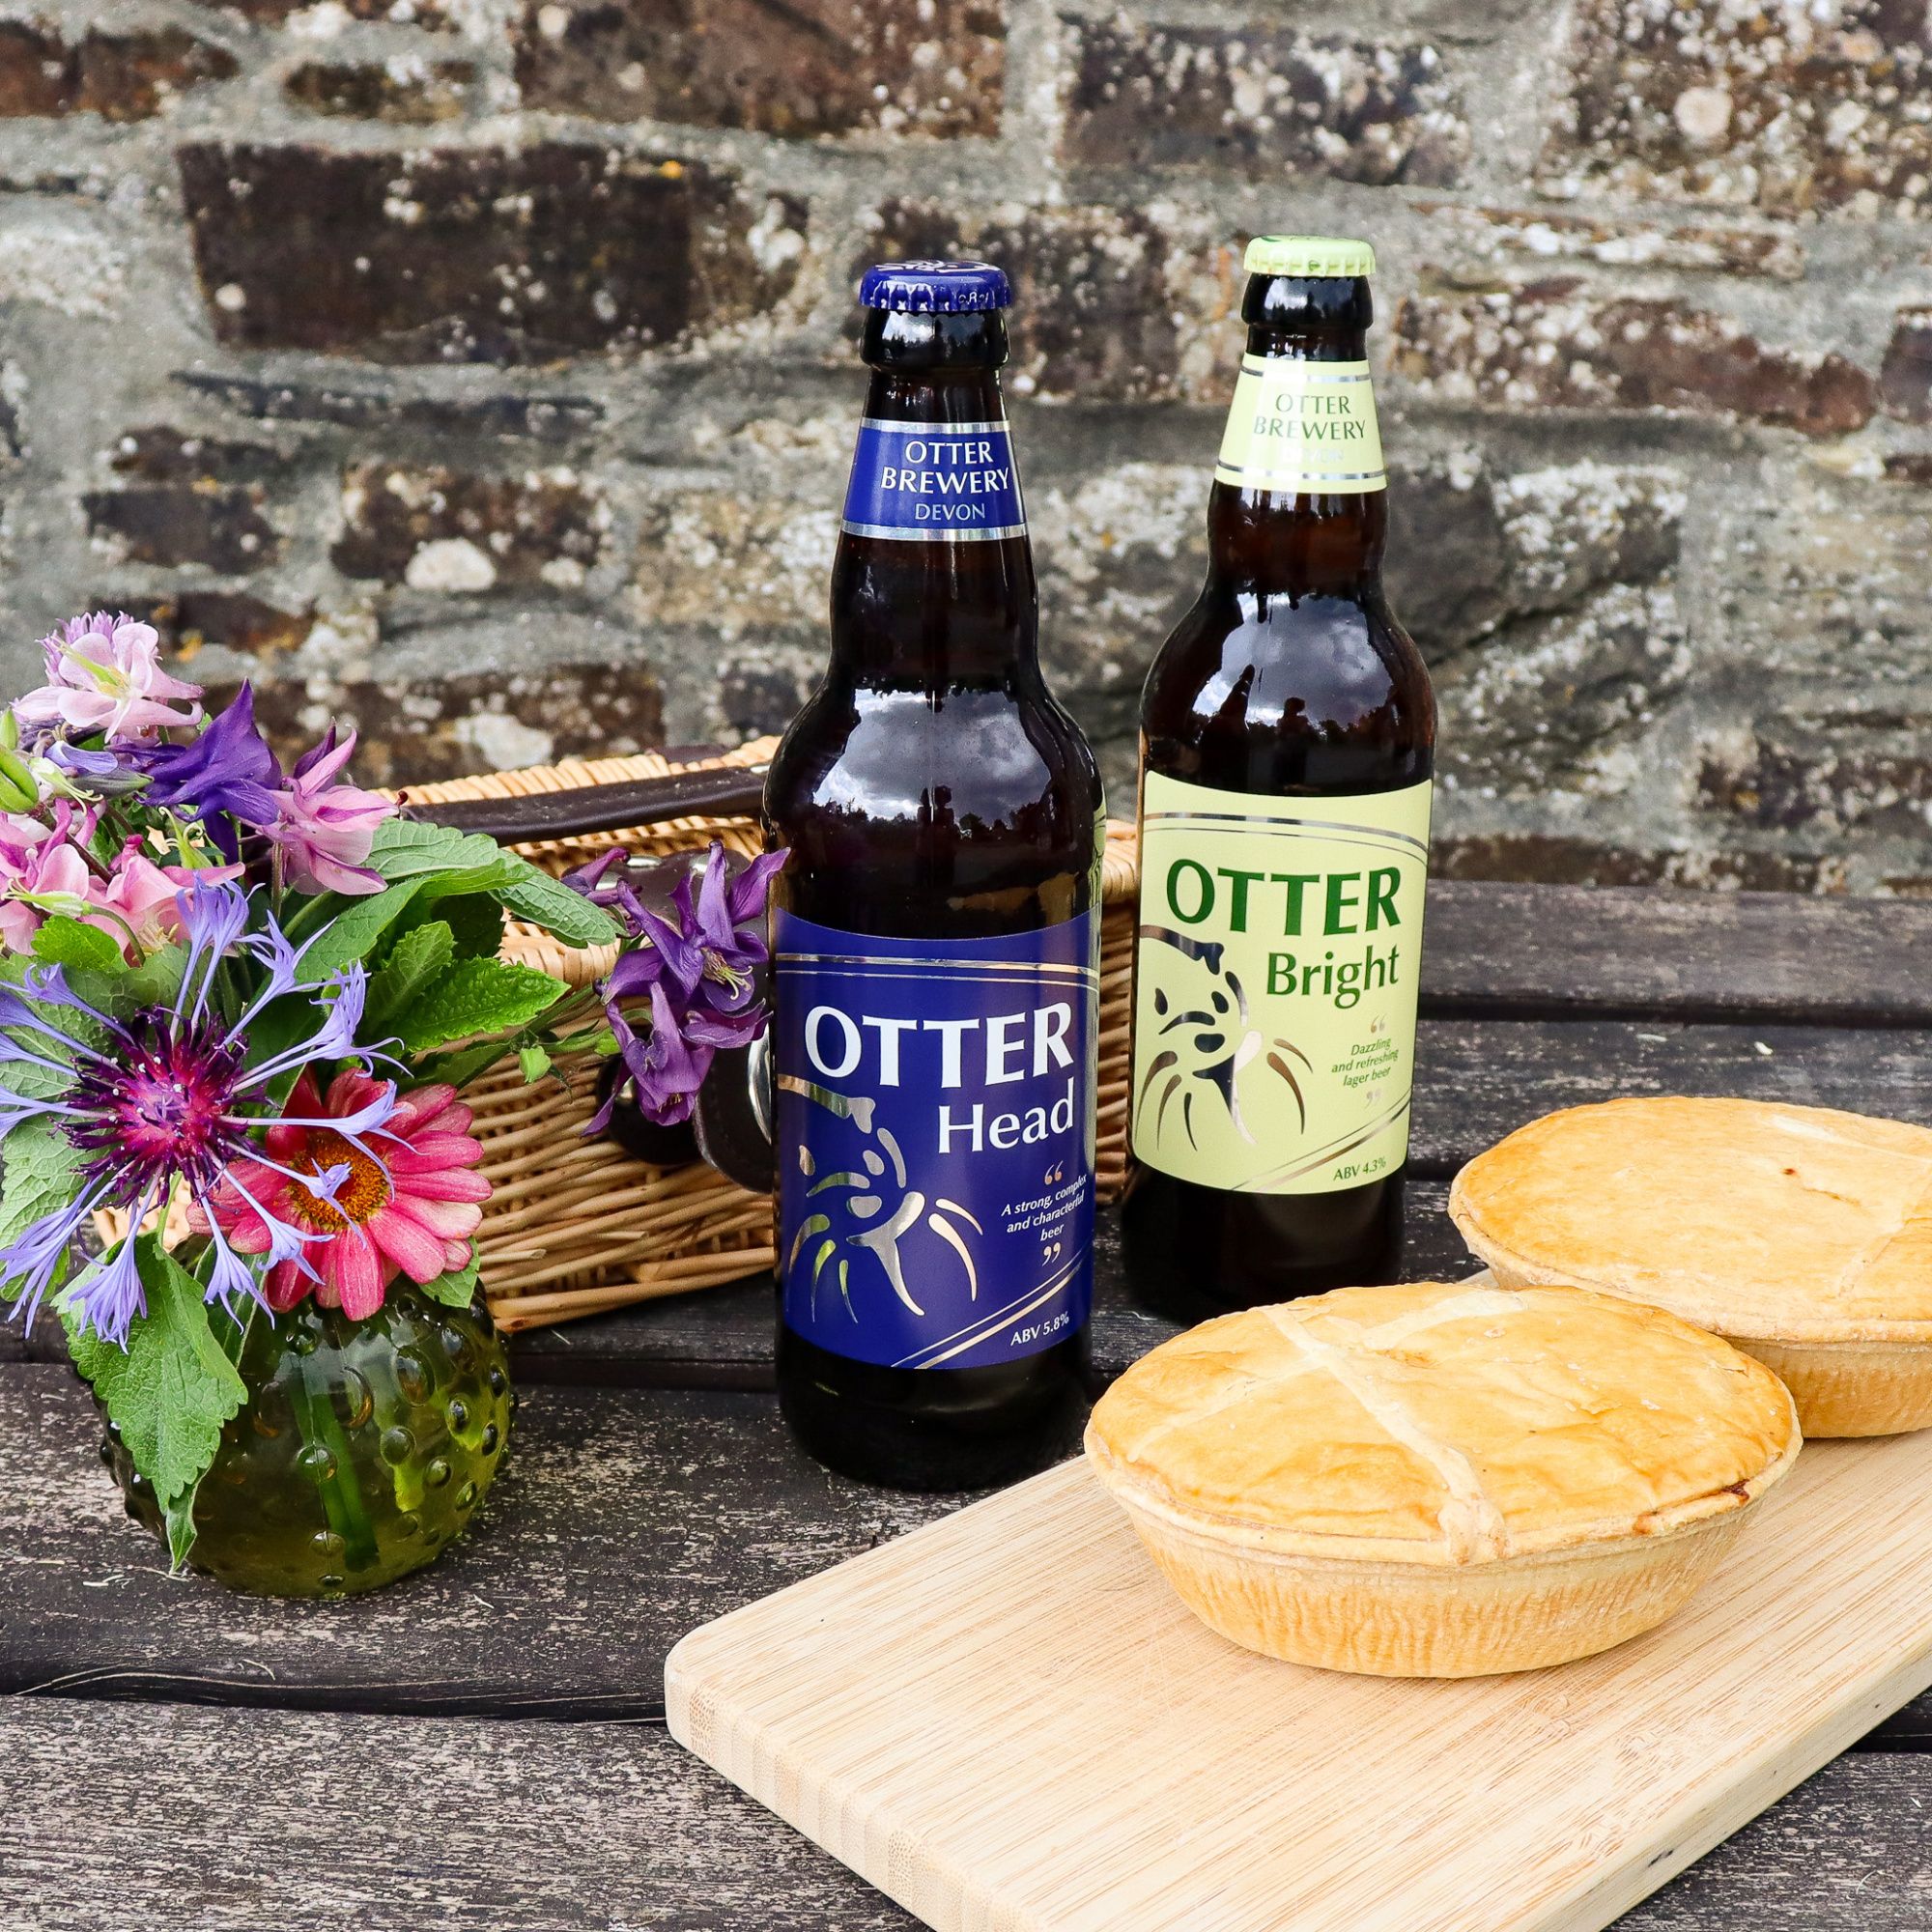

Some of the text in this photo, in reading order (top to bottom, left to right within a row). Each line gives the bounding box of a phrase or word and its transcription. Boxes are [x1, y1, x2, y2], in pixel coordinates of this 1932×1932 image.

[1275, 393, 1351, 414] OTTER
[1254, 416, 1366, 440] BREWERY
[905, 440, 993, 466] OTTER
[881, 467, 1009, 495] BREWERY
[914, 502, 985, 521] DEVON
[1166, 859, 1402, 936] OTTER
[1266, 943, 1400, 1009] Bright
[804, 1001, 1075, 1089] OTTER
[1350, 1037, 1392, 1056] Dazzling
[1331, 1049, 1399, 1073] and refreshing
[1343, 1066, 1391, 1088] lager beer
[938, 1076, 1075, 1154] Head
[1333, 1156, 1387, 1180] ABV 4.3%
[1001, 1174, 1087, 1217] A strong, complex
[1007, 1189, 1085, 1233] and characterful
[1040, 1223, 1065, 1241] beer
[1010, 1310, 1069, 1347] ABV 5.8%
